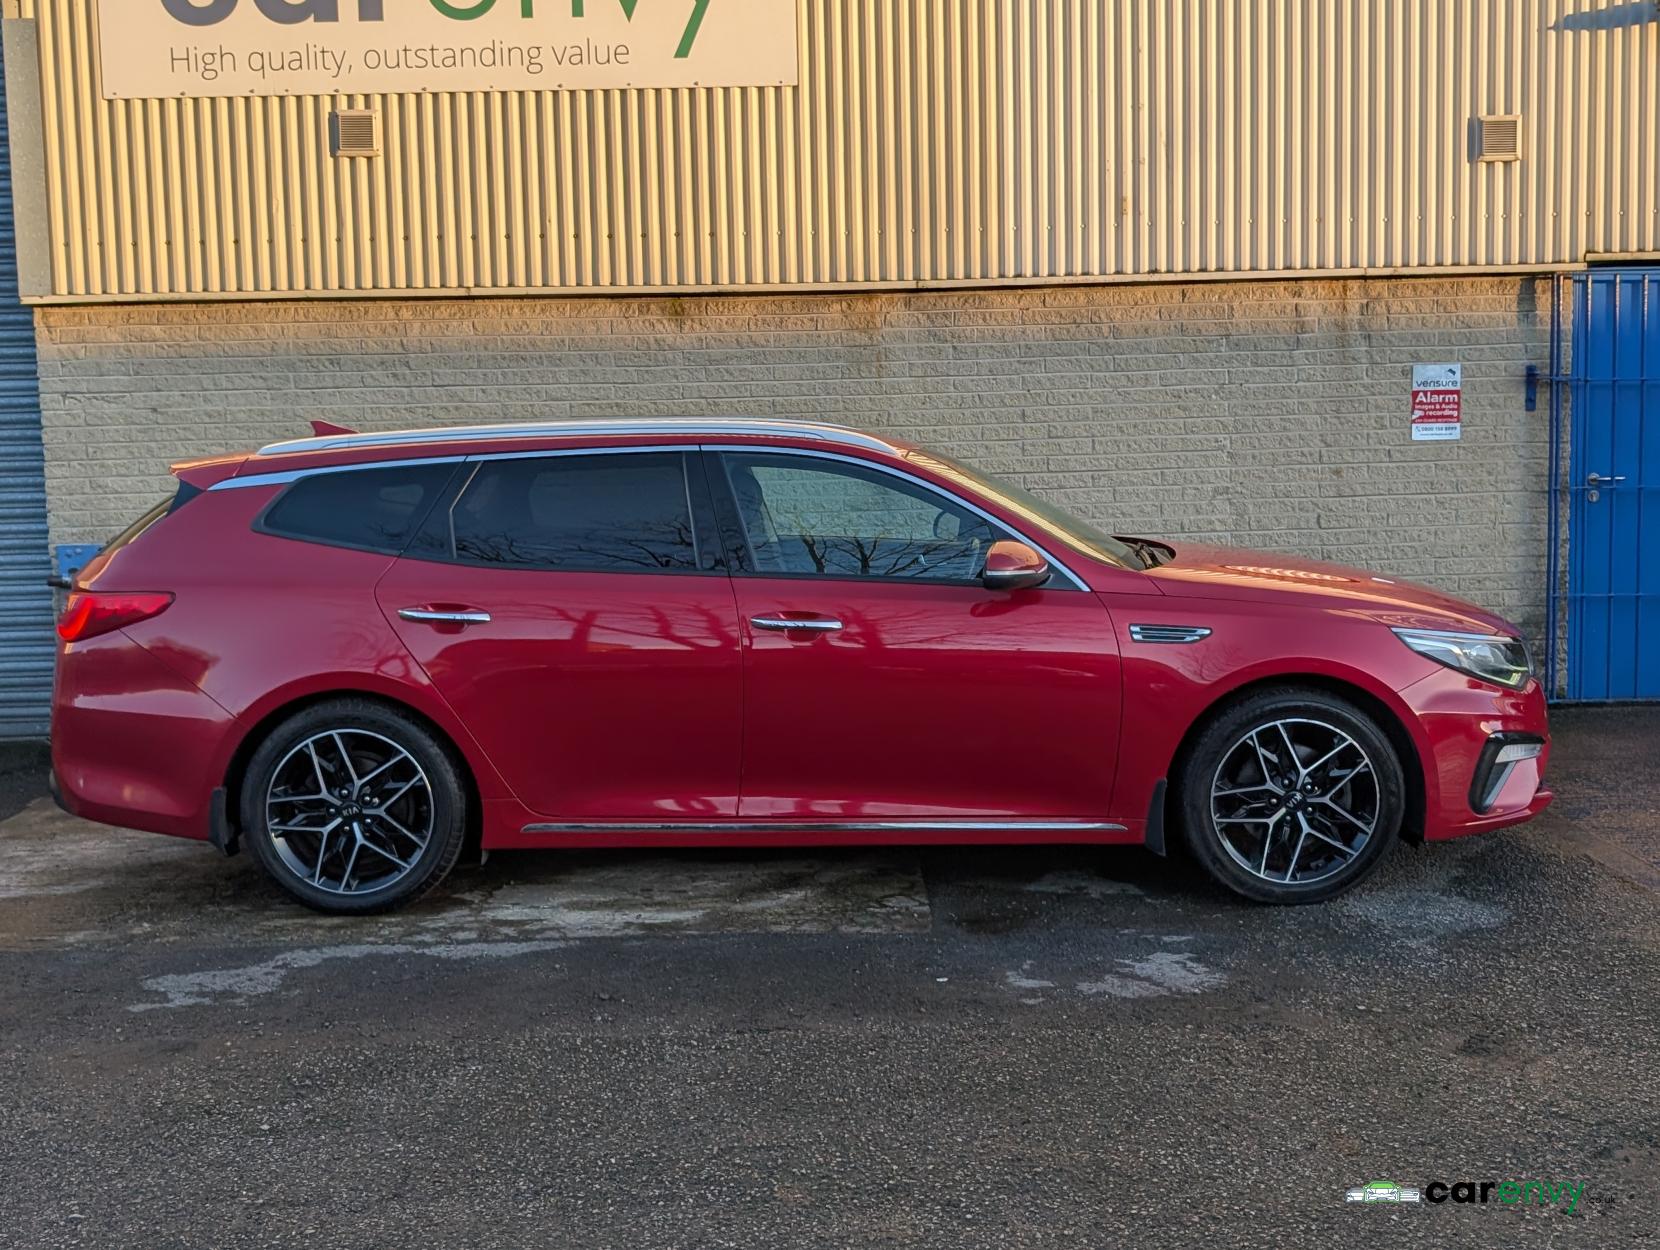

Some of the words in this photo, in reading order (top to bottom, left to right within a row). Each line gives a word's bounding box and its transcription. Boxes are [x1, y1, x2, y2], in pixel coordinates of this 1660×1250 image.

[170, 45, 237, 81] High
[247, 43, 354, 80] quality,
[363, 39, 543, 76] outstanding
[551, 37, 630, 66] value
[1415, 391, 1458, 403] Alarm
[1425, 409, 1458, 417] recording
[1286, 793, 1302, 808] KIA
[342, 806, 360, 816] KIA
